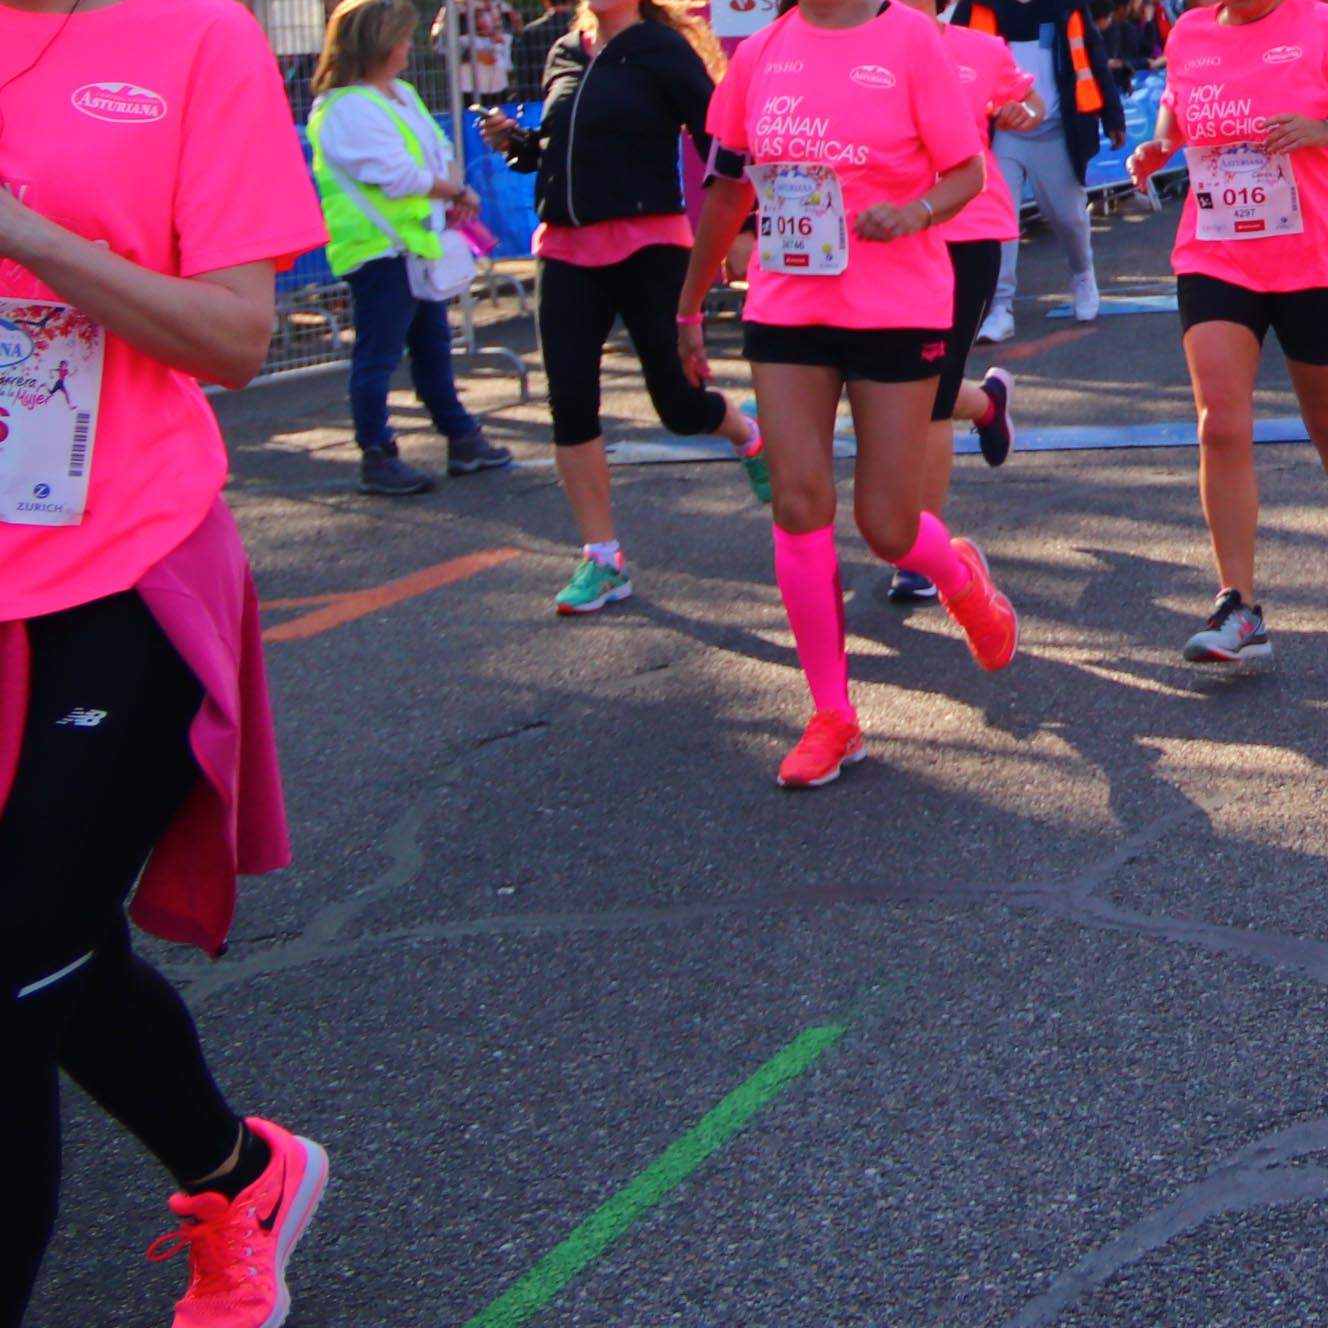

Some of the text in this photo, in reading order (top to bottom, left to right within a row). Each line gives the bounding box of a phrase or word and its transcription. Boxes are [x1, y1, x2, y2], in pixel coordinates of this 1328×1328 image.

[79, 91, 159, 116] ASTURIANA
[1189, 84, 1225, 103] HOY
[762, 96, 804, 115] HOY
[1186, 98, 1251, 122] GANAN
[756, 116, 829, 137] GANAN
[1188, 116, 1272, 140] LAS CHIC
[755, 137, 870, 166] LAS CHICAS
[1223, 187, 1266, 206] 016
[778, 216, 812, 236] 016
[16, 502, 63, 513] ZURICH
